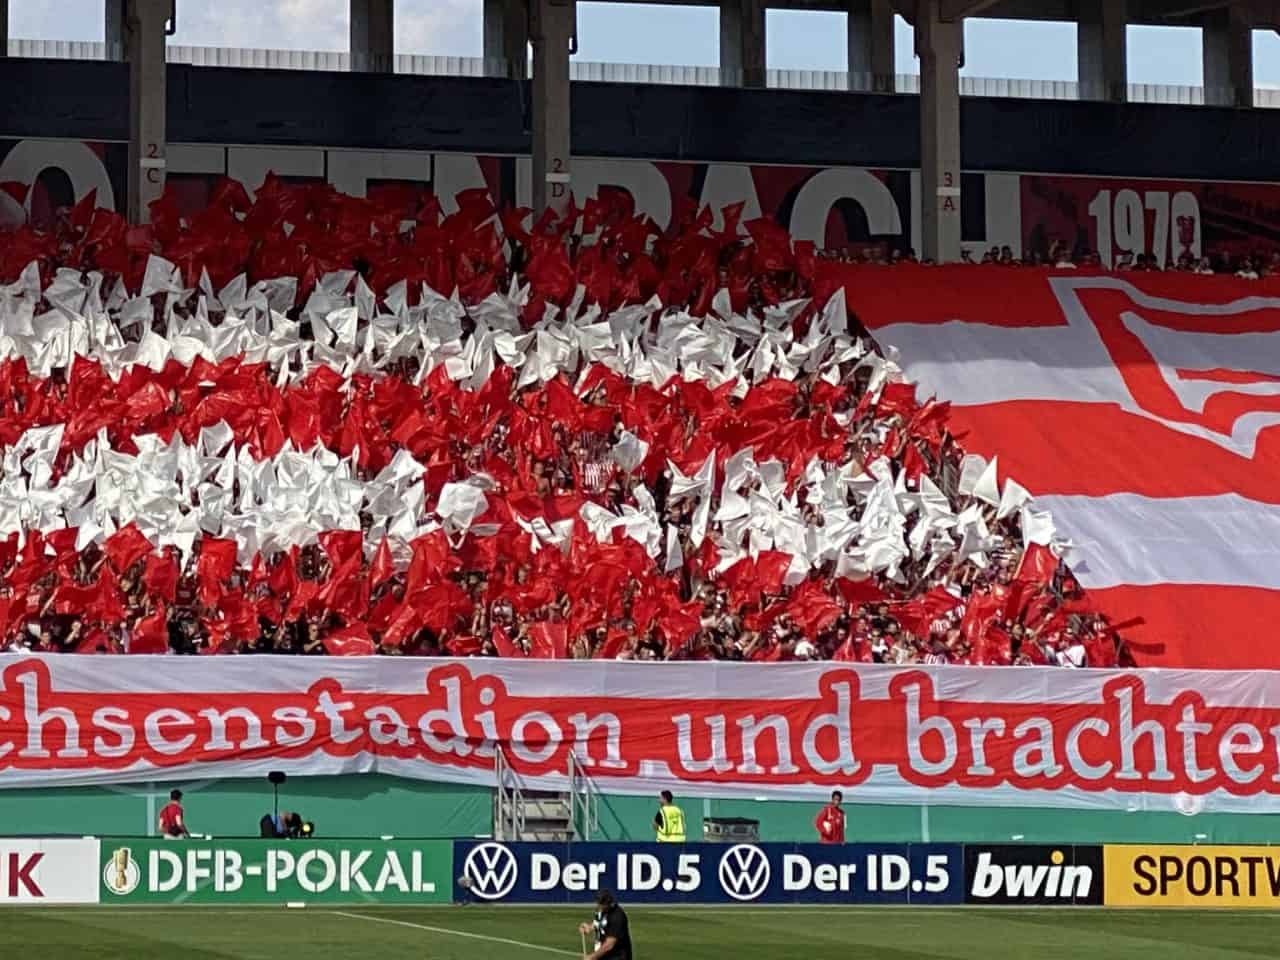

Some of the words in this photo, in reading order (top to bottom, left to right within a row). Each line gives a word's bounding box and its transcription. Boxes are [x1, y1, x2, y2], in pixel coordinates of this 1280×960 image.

[147, 144, 158, 159] 2
[146, 168, 159, 184] C
[551, 182, 565, 198] D
[942, 196, 955, 211] A
[1089, 189, 1201, 271] 1970
[672, 682, 861, 775] und
[902, 683, 1280, 784] brachte
[148, 849, 435, 892] DFB-POKAL
[530, 854, 605, 892] Der
[617, 854, 701, 892] ID.5
[783, 855, 857, 893] Der
[867, 855, 949, 893] ID.5
[972, 850, 1092, 898] bwin
